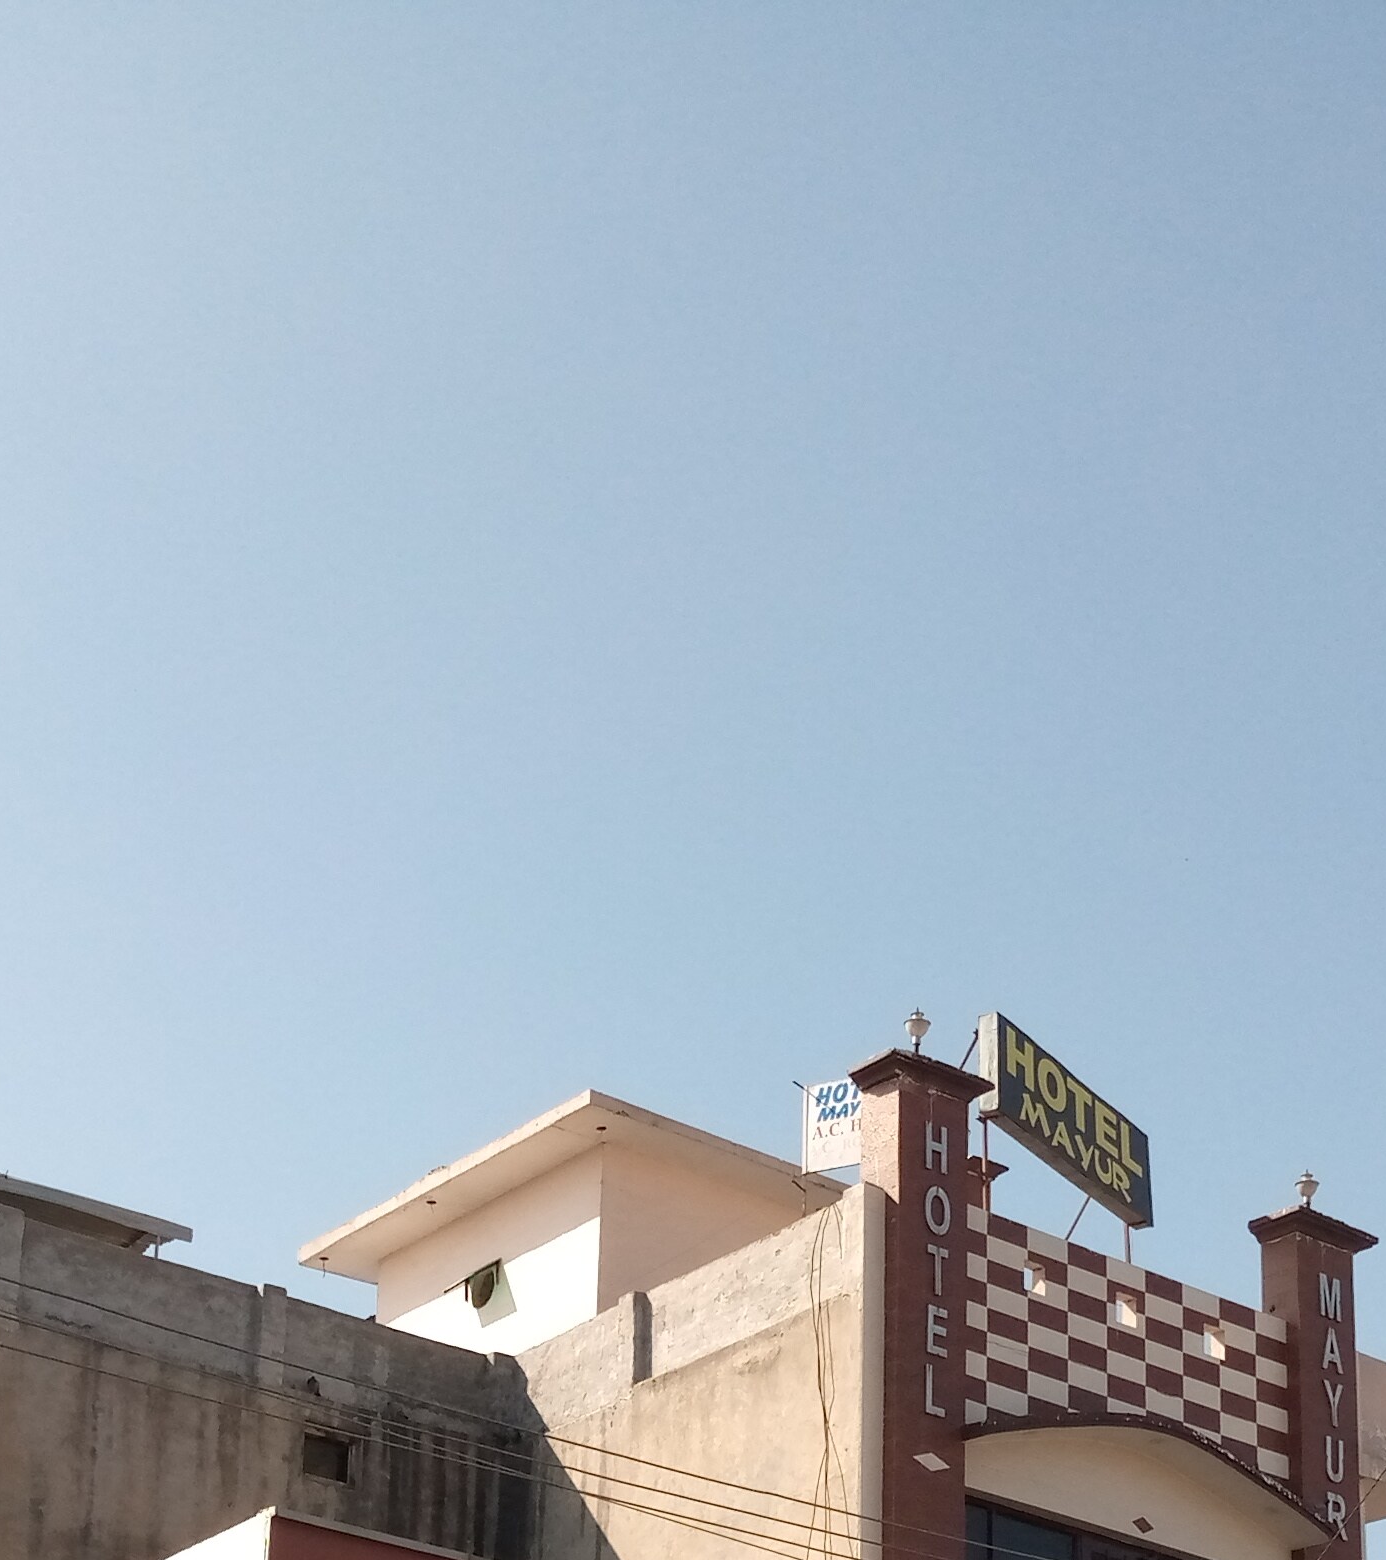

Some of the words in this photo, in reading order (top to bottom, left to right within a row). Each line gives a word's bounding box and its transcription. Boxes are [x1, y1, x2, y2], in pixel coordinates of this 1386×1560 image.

[816, 1100, 861, 1123] MAY
[1005, 1025, 1143, 1178] HOTEL
[1019, 1092, 1133, 1204] MAYUR
[924, 1120, 951, 1418] HOTEL
[1317, 1272, 1349, 1543] MAYUR
